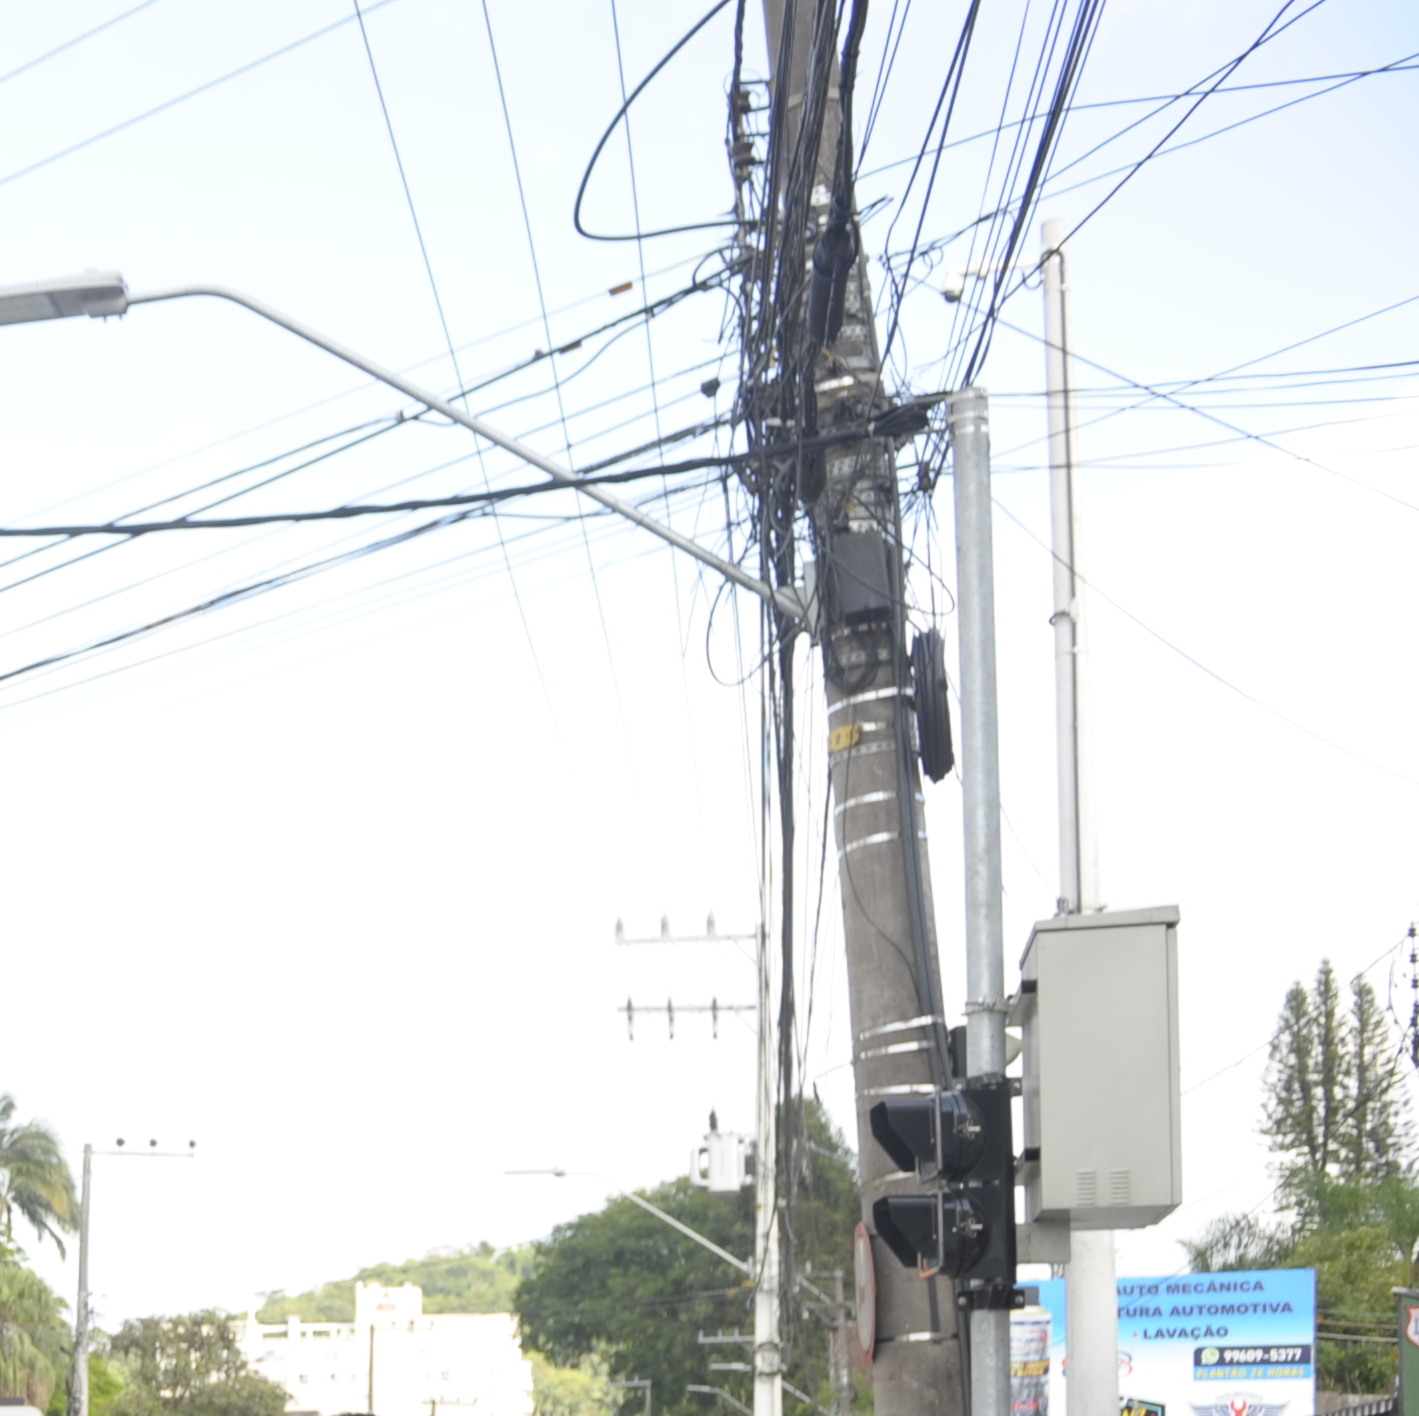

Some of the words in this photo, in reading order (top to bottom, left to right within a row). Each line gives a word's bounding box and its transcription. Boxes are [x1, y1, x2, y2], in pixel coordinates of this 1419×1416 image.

[1166, 1279, 1265, 1296] MECÂNICA
[1169, 1302, 1294, 1318] AUTOMOTIVA
[1143, 1325, 1229, 1341] LAVAÇÃO
[1223, 1347, 1303, 1363] 99609-5377
